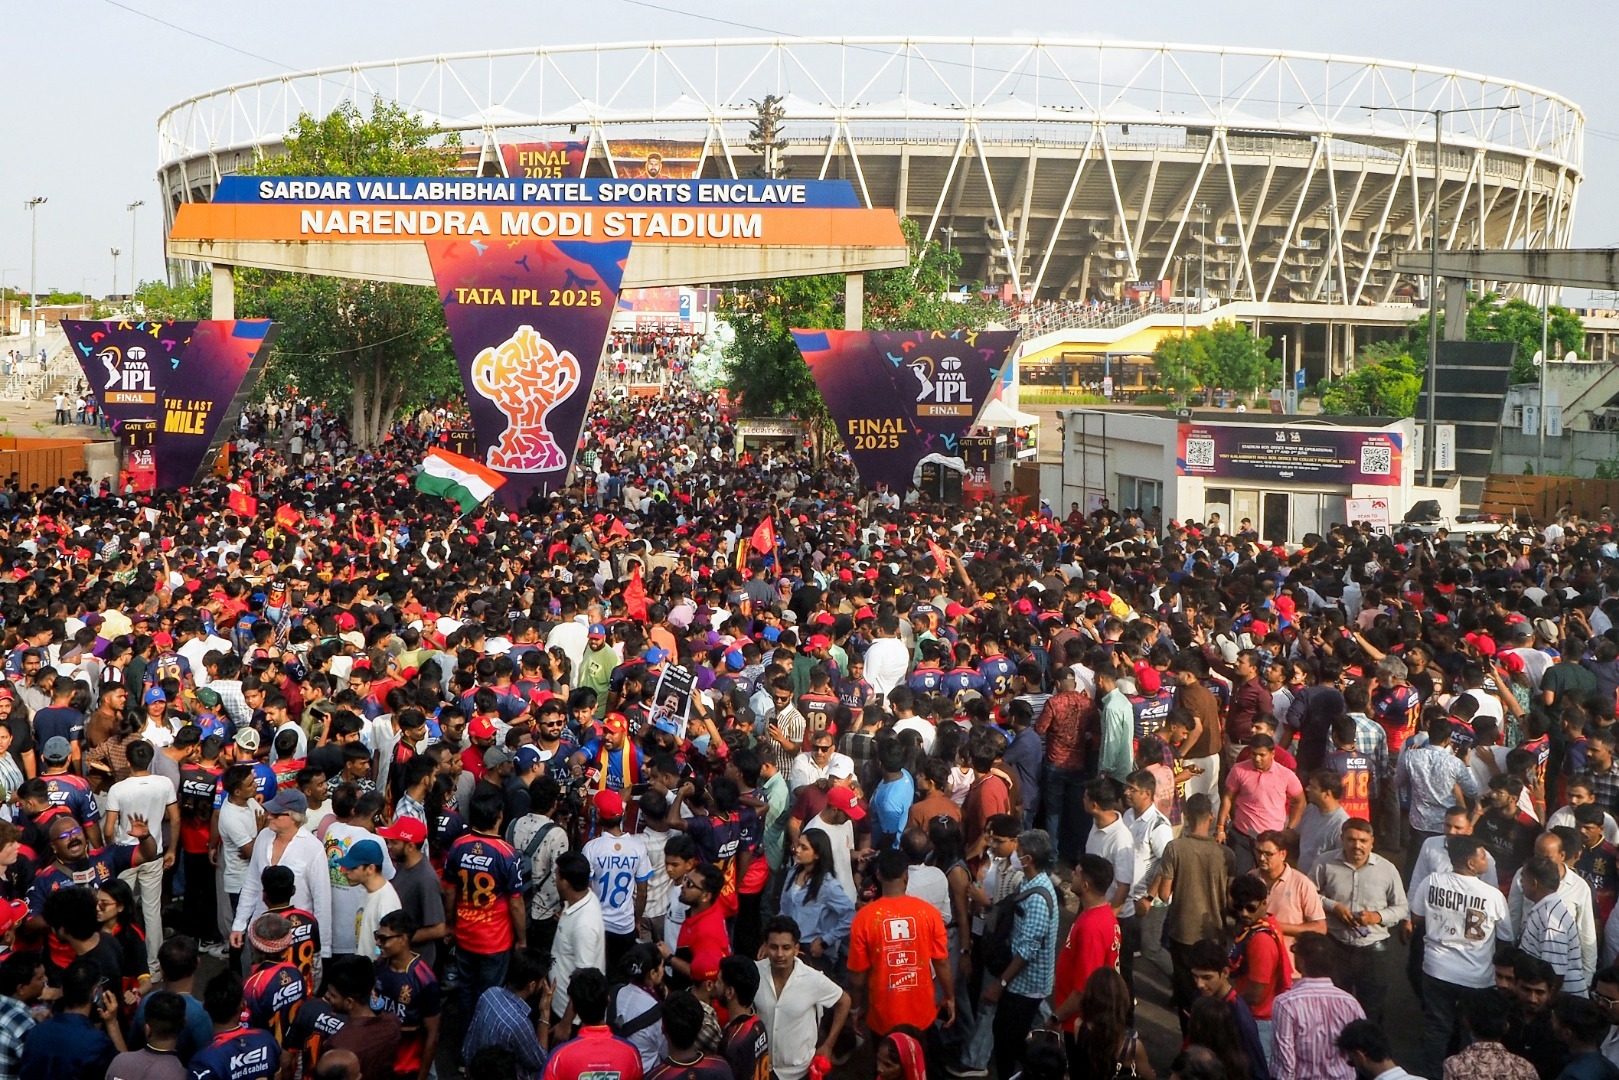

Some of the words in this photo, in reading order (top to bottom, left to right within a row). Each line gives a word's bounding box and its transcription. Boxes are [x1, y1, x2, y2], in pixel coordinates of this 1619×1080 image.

[518, 151, 570, 166] FINAL
[524, 167, 562, 179] 2025
[259, 181, 351, 199] SARDAR
[357, 182, 516, 201] VALLABHBHAI
[523, 183, 592, 202] PATEL
[598, 183, 693, 203] SPORTS
[701, 184, 806, 204] ENCLAVE
[300, 210, 492, 236] NARENDRA
[501, 211, 592, 237] MODI
[603, 211, 763, 239] STADIUM
[455, 288, 506, 305] TATA
[511, 289, 543, 306] IPL
[548, 290, 602, 307] 2025
[680, 296, 690, 309] 2
[122, 370, 156, 390] IPL
[116, 393, 143, 402] FINAL
[935, 381, 973, 402] IPL
[164, 399, 182, 409] THE
[187, 400, 213, 412] LAST
[929, 405, 960, 415] FINAL
[164, 410, 207, 435] MILE
[848, 418, 908, 435] FINAL
[129, 433, 136, 445] 1
[148, 432, 153, 444] 1
[854, 435, 900, 450] 2025
[456, 442, 462, 454] 1
[982, 448, 988, 461] 1
[840, 695, 858, 704] ATAR
[1140, 704, 1169, 716] KEI
[807, 712, 827, 731] 18
[183, 780, 215, 792] KEI
[1343, 771, 1369, 798] 18
[461, 853, 493, 866] KEI
[597, 856, 639, 869] VIRAT
[457, 869, 497, 908] 18
[598, 871, 632, 909] 18
[889, 919, 910, 940] R
[1464, 909, 1486, 940] B
[272, 980, 303, 1006] KEI
[316, 1013, 344, 1031] KEI
[754, 1032, 766, 1052] KEI
[230, 1046, 268, 1071] KEI
